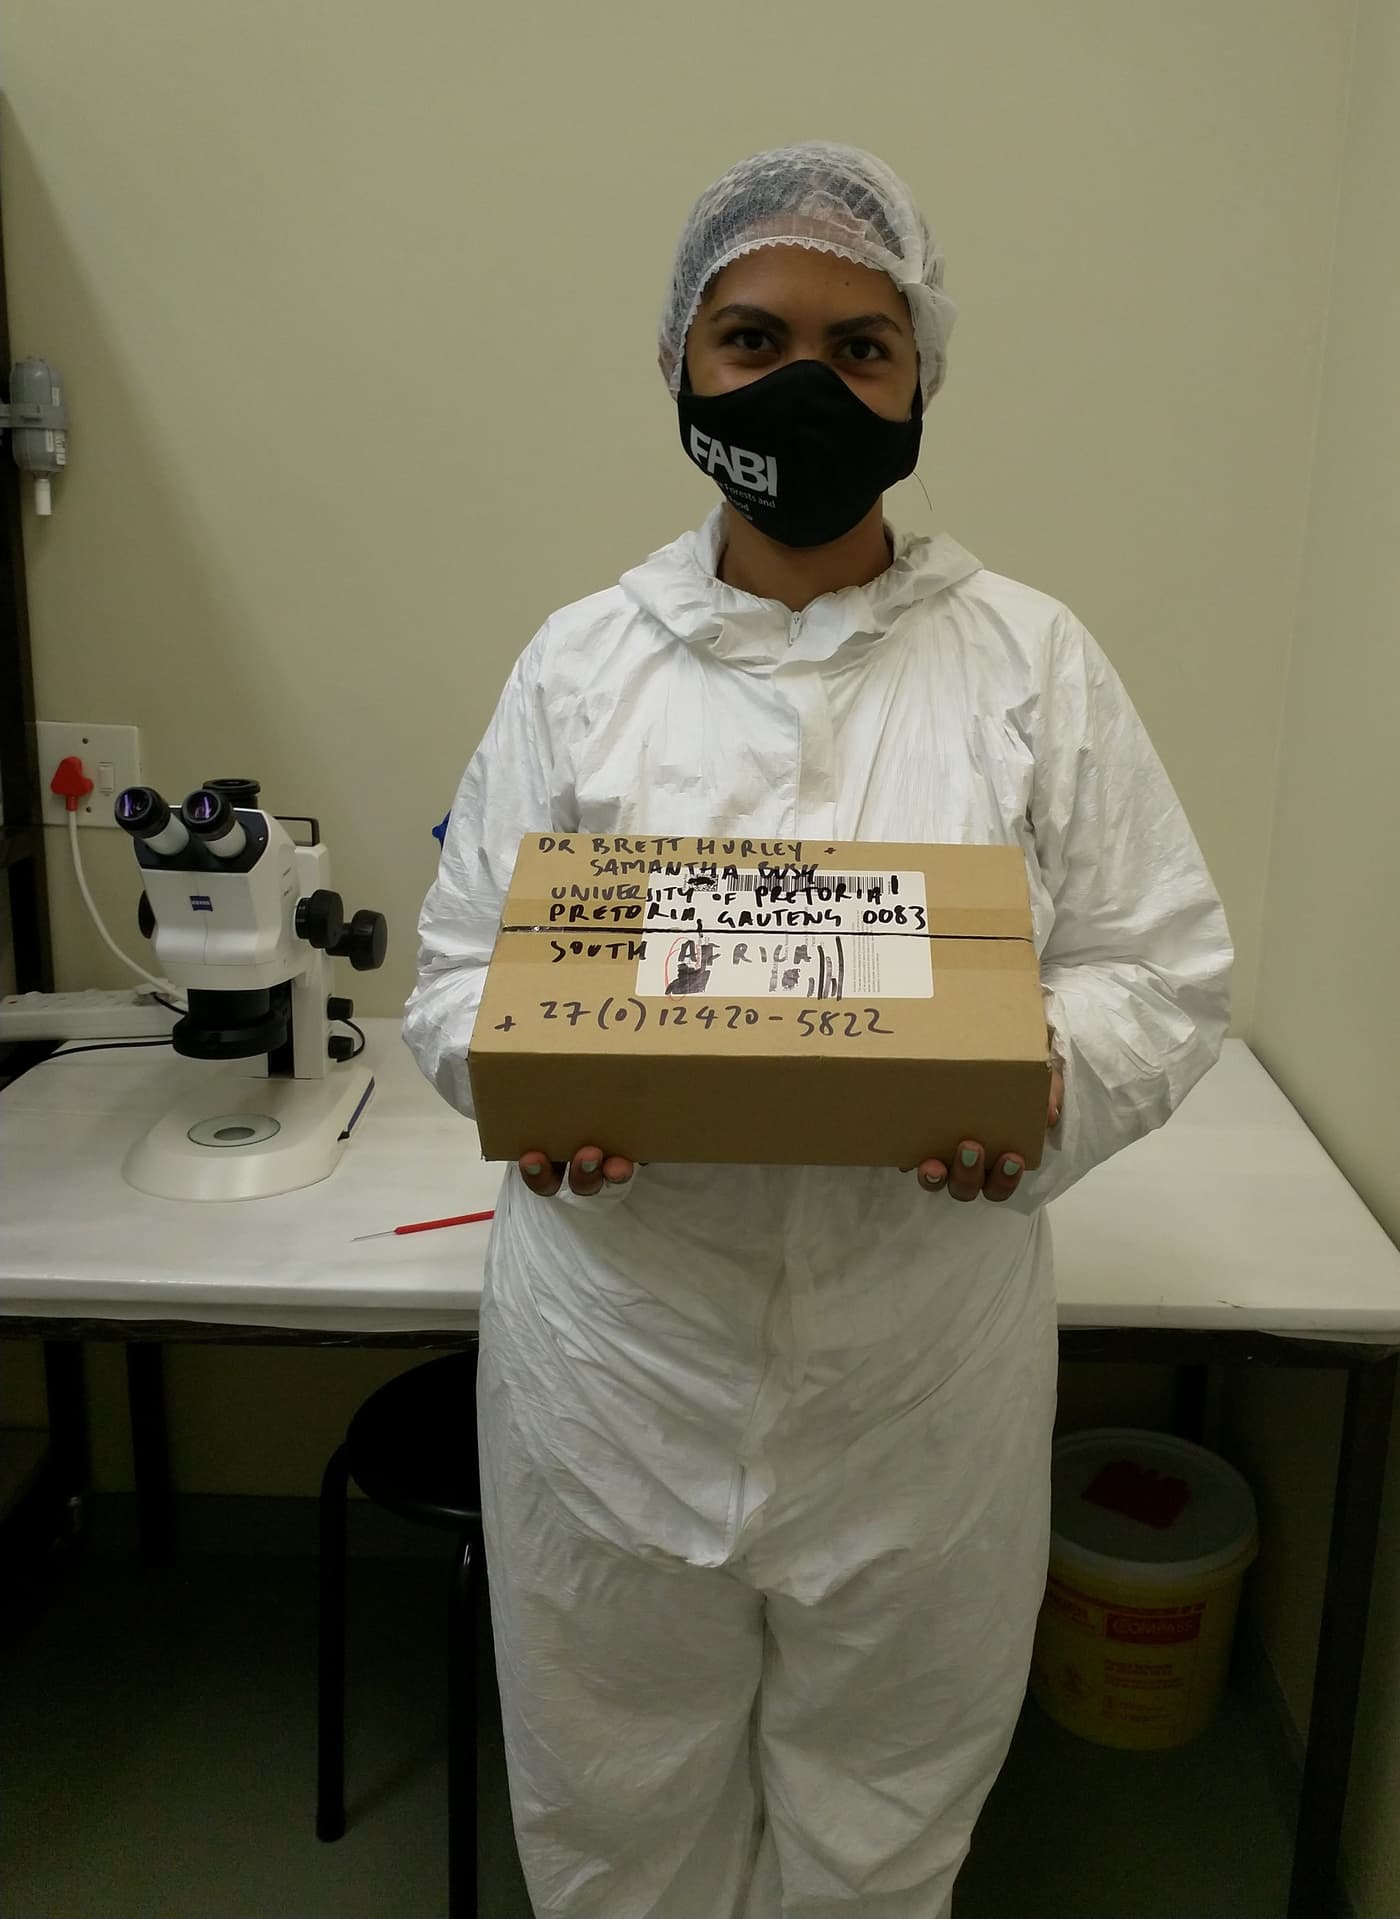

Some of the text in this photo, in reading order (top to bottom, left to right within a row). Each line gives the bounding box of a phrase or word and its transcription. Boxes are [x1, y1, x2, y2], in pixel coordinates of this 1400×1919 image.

[690, 423, 778, 497] FABI
[538, 837, 575, 853] DR
[592, 838, 684, 854] BRETT
[697, 838, 802, 861] HURLEY
[590, 858, 739, 880] SAMANTHA
[551, 884, 695, 903] UNIVERSITY
[712, 892, 737, 905] OF
[755, 883, 882, 907] PRETORIA
[717, 909, 842, 929] GAUTENG
[863, 905, 927, 931] 0083
[551, 940, 648, 963] SOUTH
[678, 940, 812, 966] AFRICA
